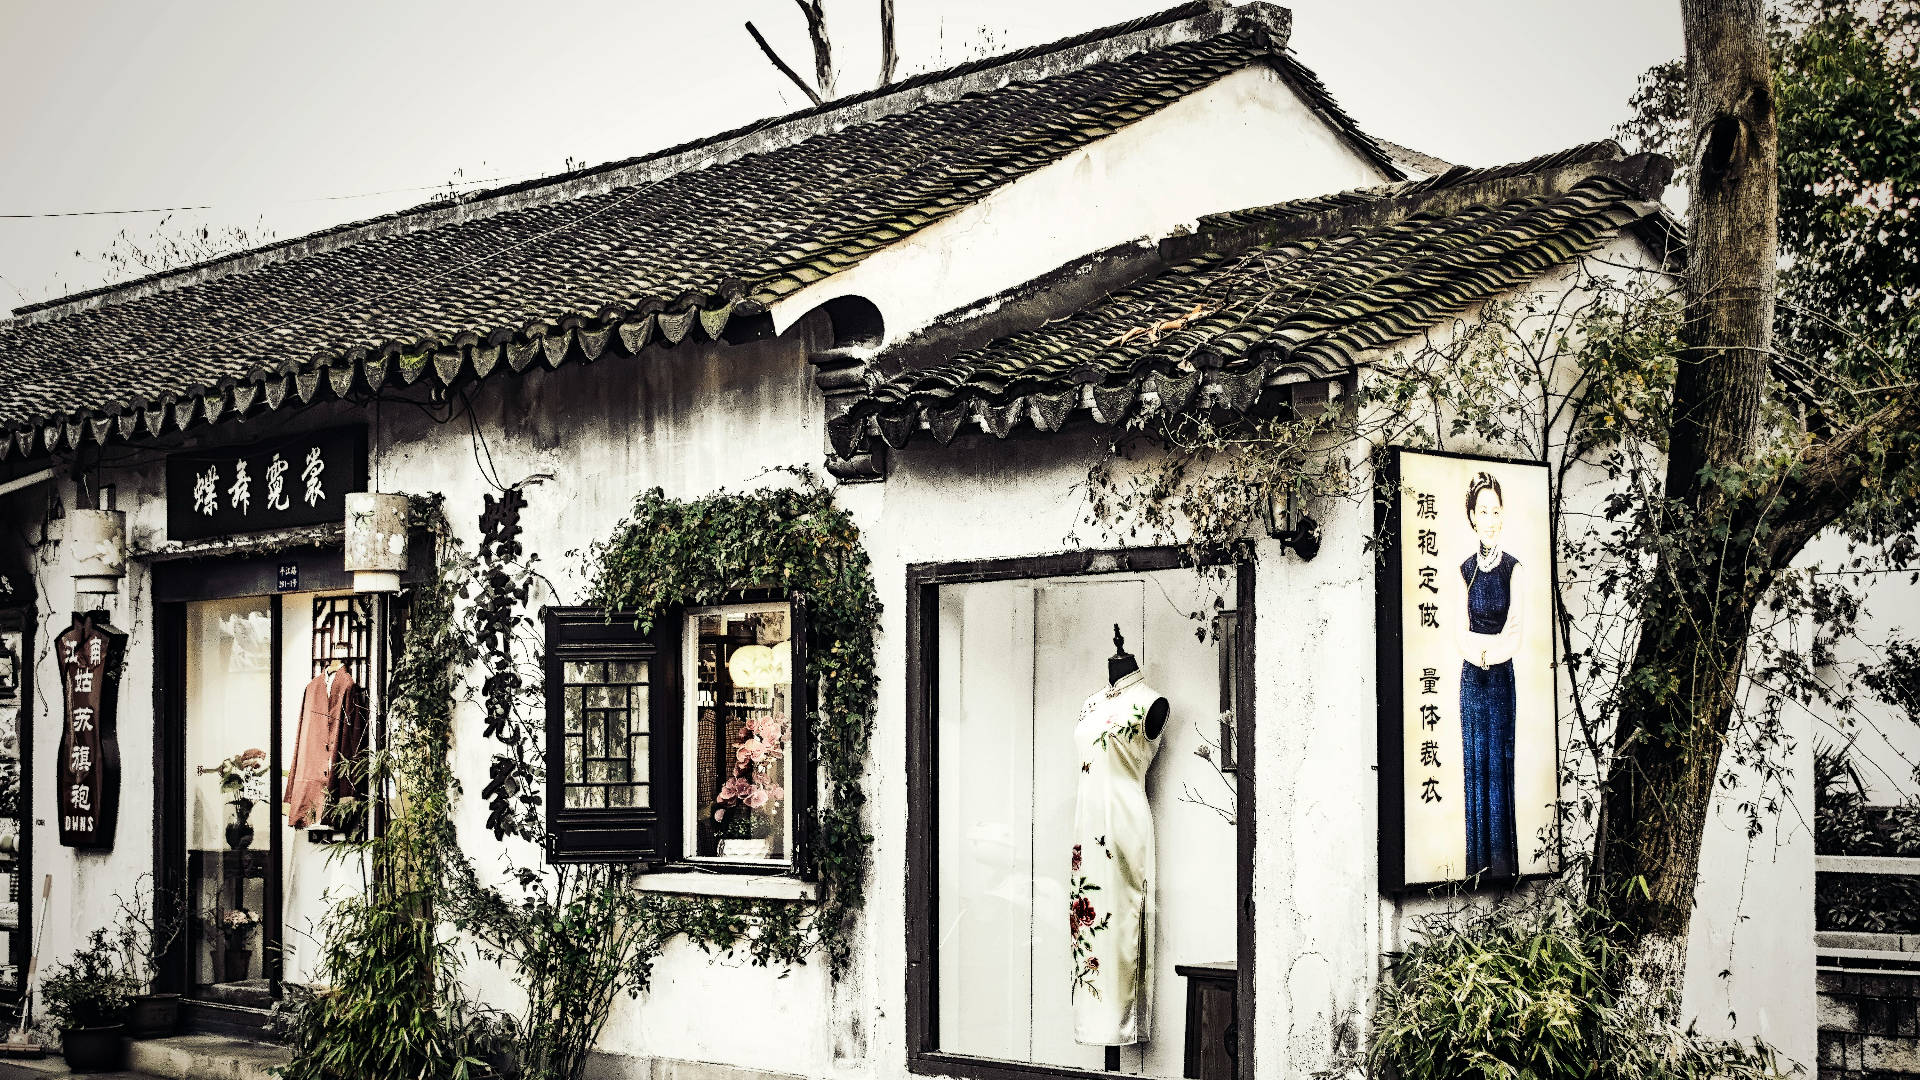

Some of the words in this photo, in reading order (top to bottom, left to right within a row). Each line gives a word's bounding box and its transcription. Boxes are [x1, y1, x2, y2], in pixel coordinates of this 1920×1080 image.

[193, 446, 326, 516] 蝶舞霓裳
[279, 565, 297, 576] 平江路
[1416, 492, 1440, 629] 旗袍定做
[70, 667, 94, 811] 姑苏旗袍
[1419, 667, 1443, 804] 量体裁衣
[64, 815, 95, 833] DWNS
